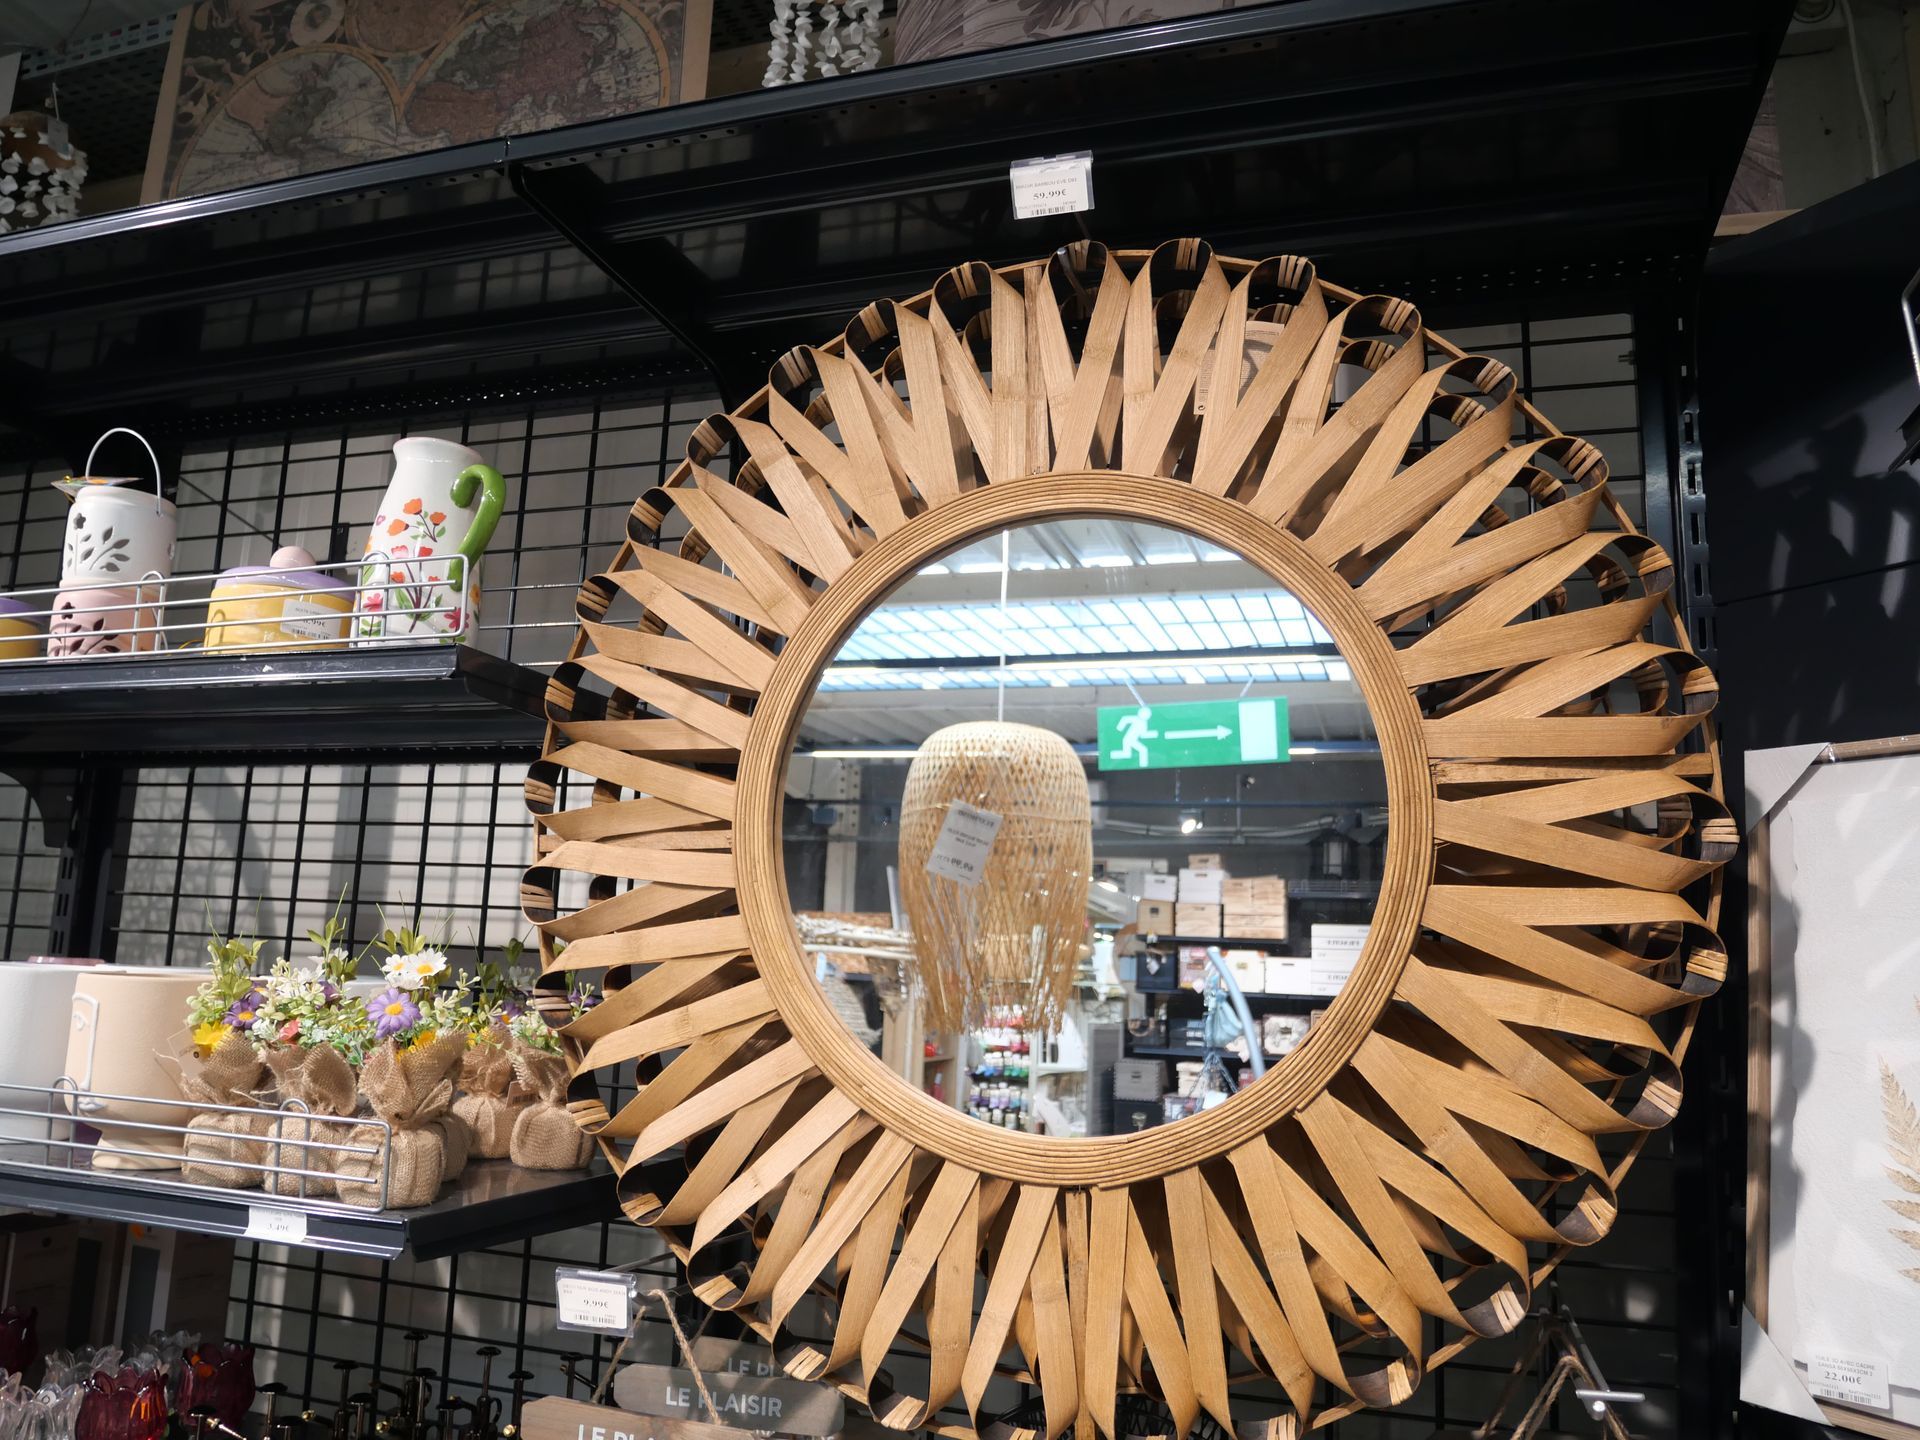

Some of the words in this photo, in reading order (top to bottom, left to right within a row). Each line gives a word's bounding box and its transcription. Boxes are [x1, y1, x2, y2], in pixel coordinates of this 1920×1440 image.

[1033, 188, 1067, 201] 59.99€
[583, 1297, 609, 1308] 9.99€
[1824, 1371, 1862, 1385] 22.00€
[665, 1385, 691, 1408] LE
